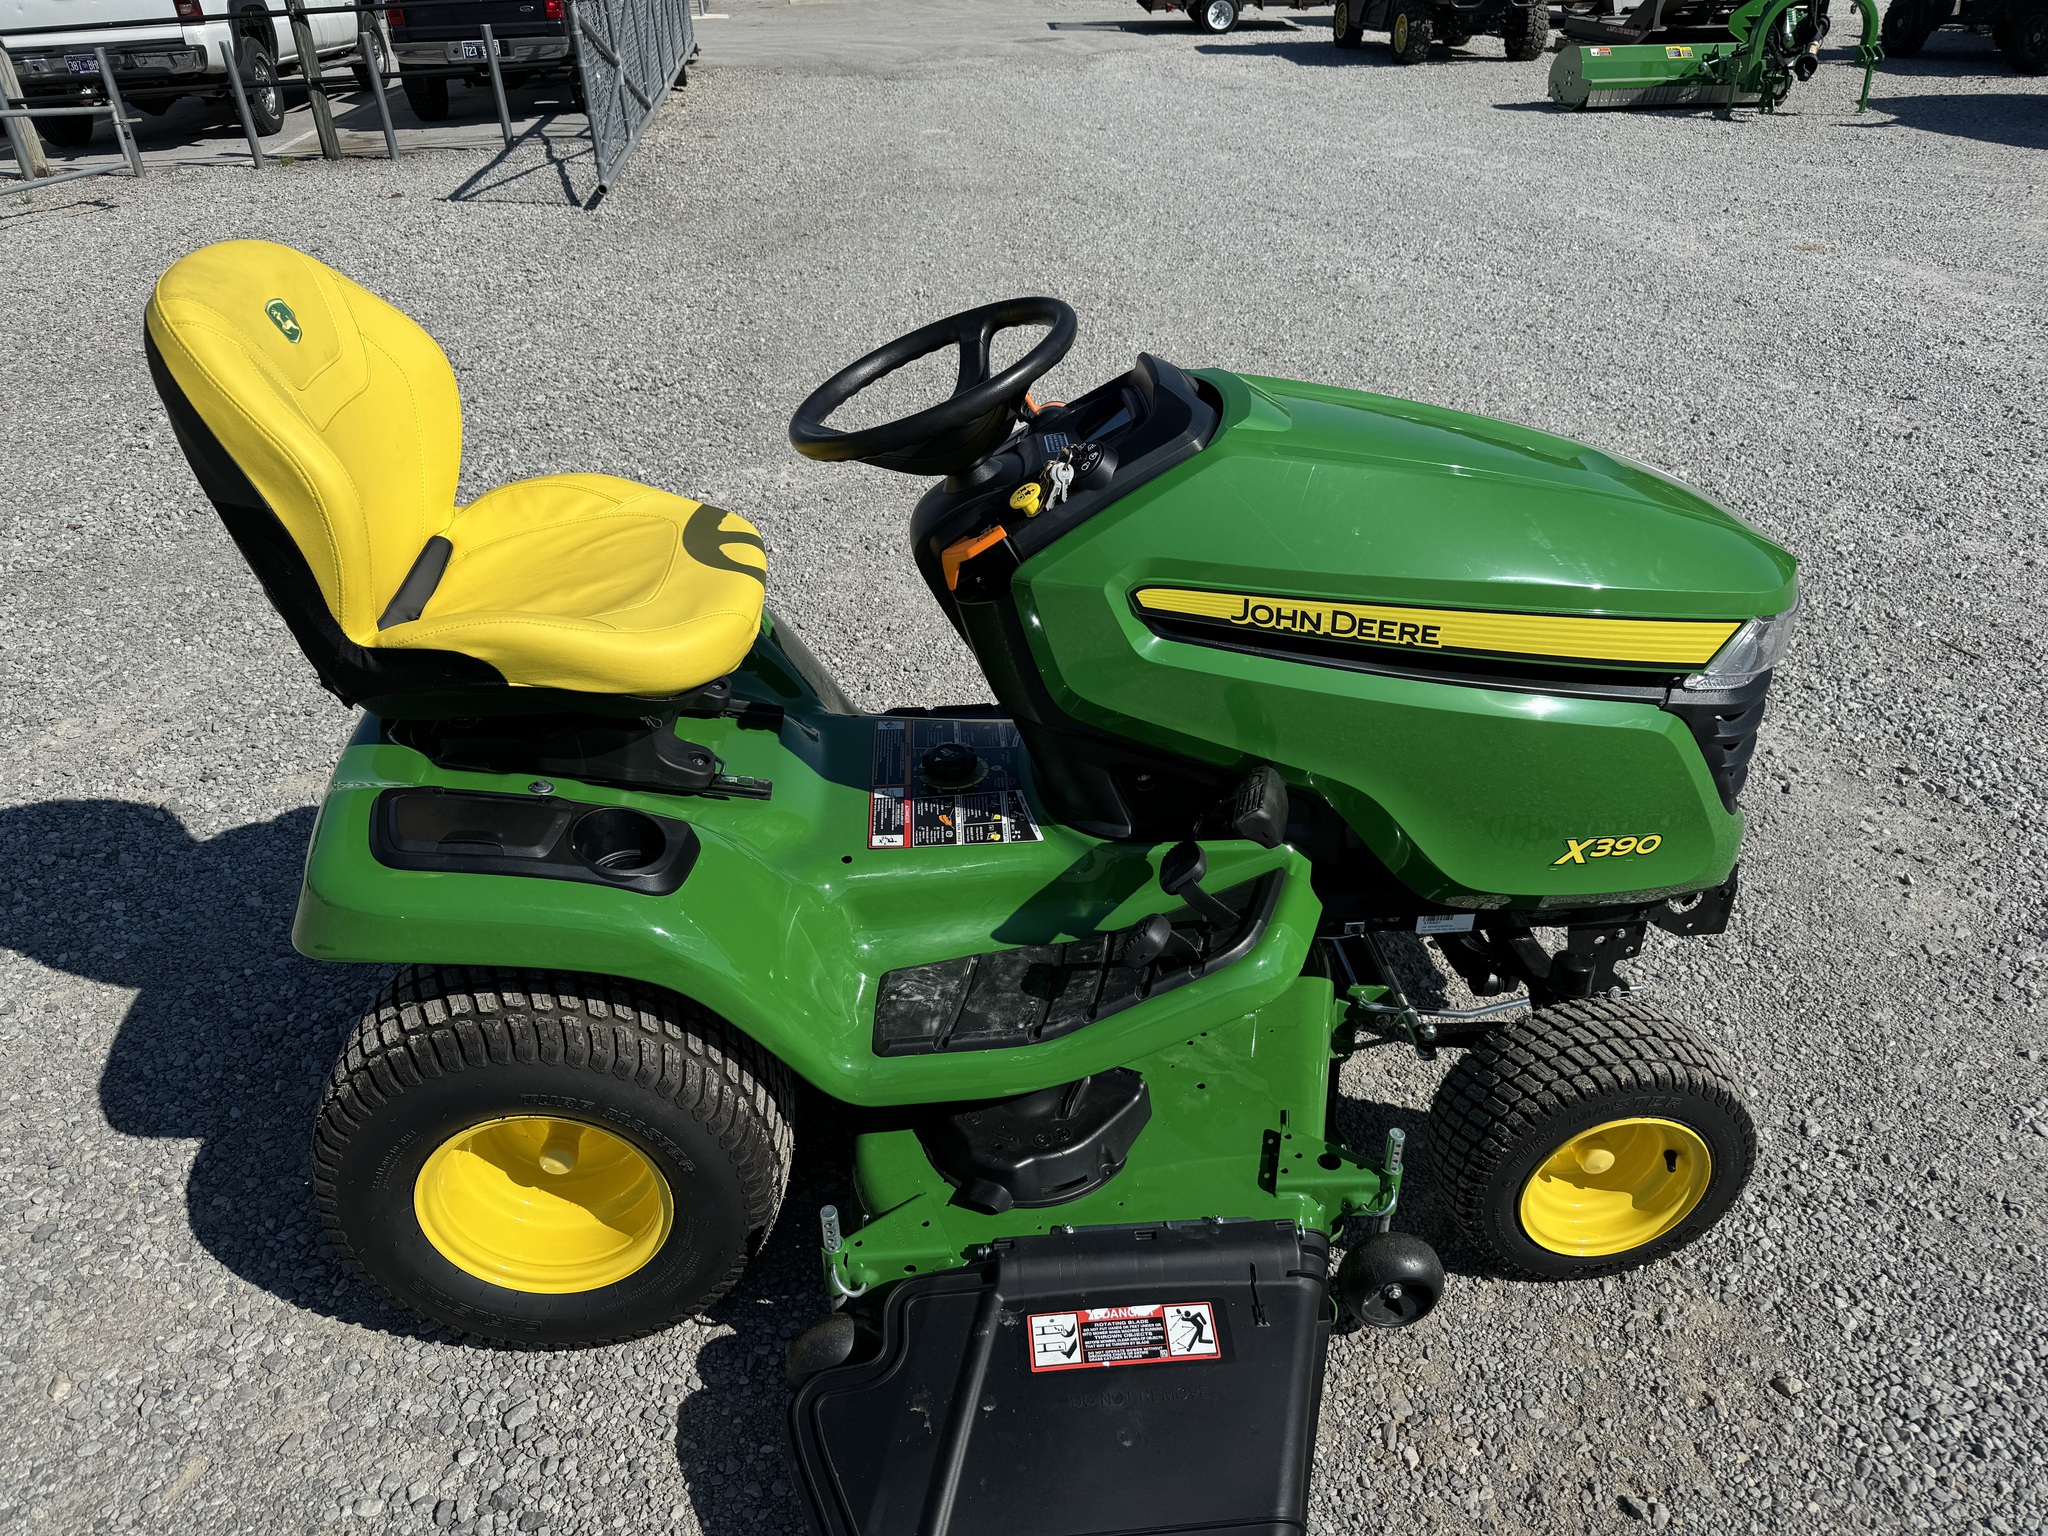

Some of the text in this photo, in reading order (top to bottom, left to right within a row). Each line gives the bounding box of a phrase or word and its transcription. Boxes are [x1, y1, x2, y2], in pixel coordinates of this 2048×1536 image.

[464, 46, 478, 57] 723
[1230, 597, 1442, 647] JOHN DEERE
[1552, 833, 1664, 867] X390
[519, 1092, 595, 1112] TURF
[1507, 1095, 1684, 1170] TURF MASTER
[1070, 1385, 1211, 1409] DO NOT REMOVE
